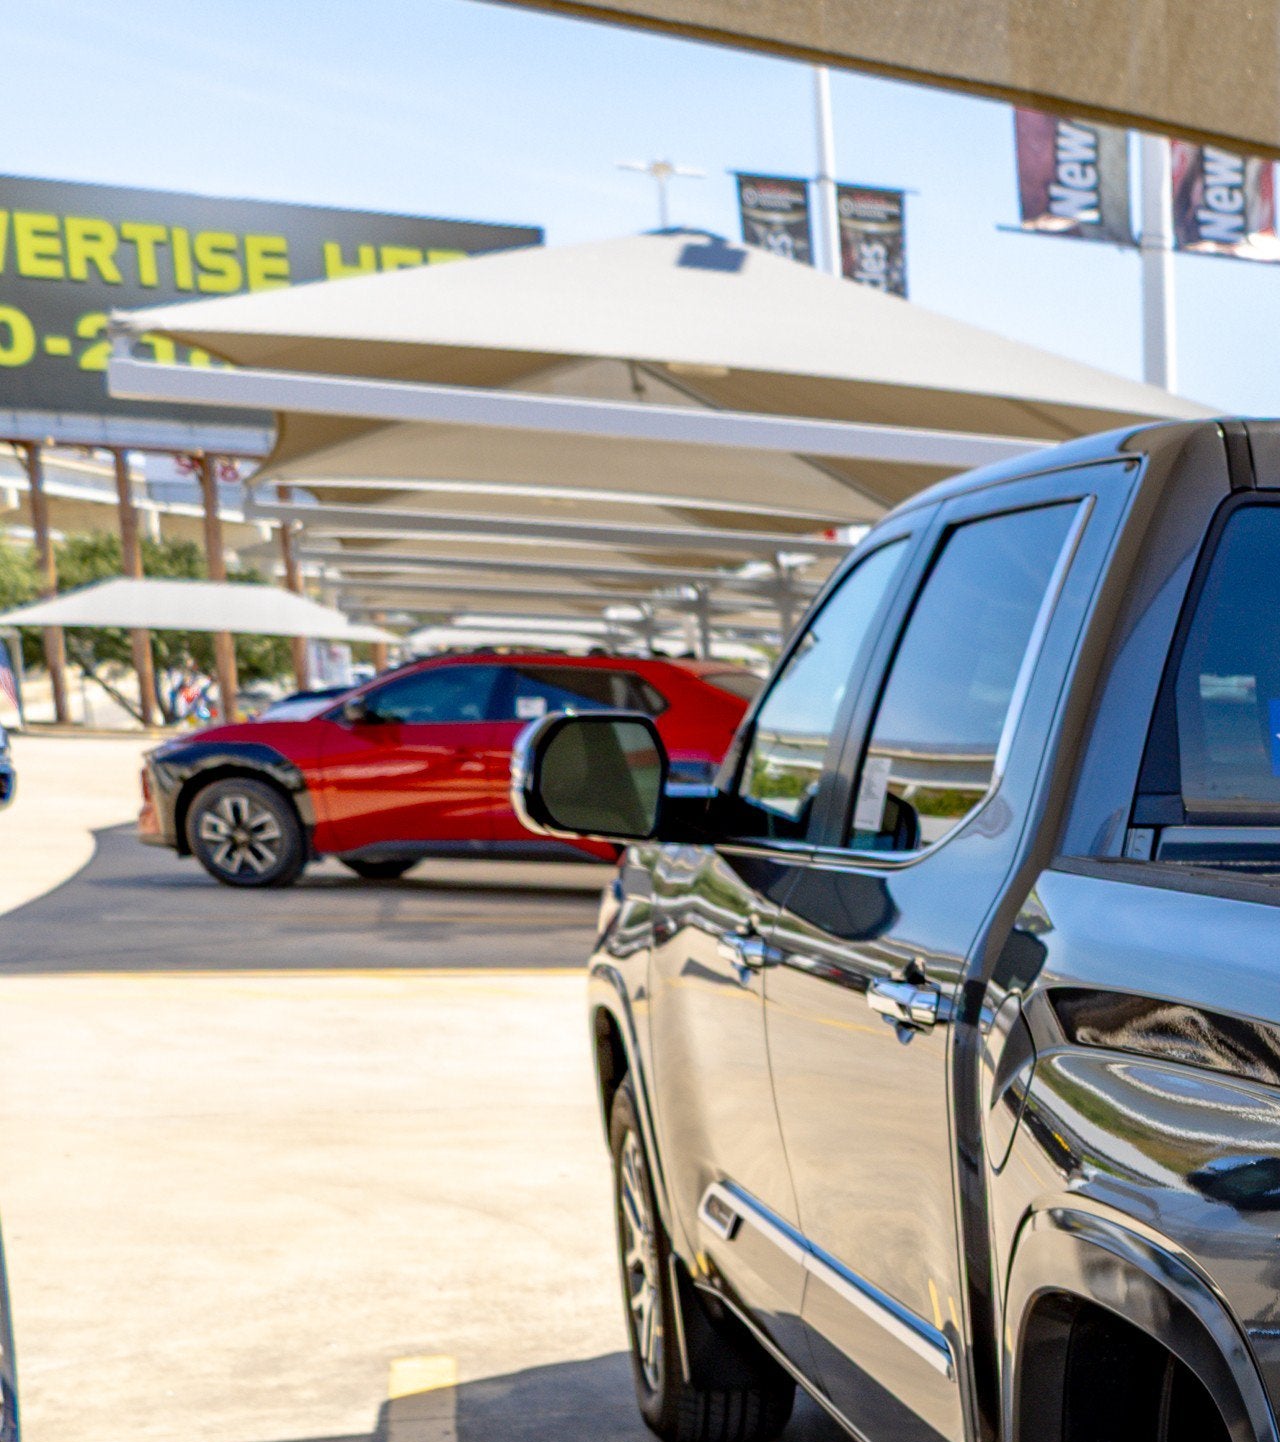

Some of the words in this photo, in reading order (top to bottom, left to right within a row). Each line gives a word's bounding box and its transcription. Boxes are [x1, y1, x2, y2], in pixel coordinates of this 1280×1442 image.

[1048, 120, 1100, 223] New
[1196, 145, 1247, 244] New
[0, 209, 293, 294] ERTISE
